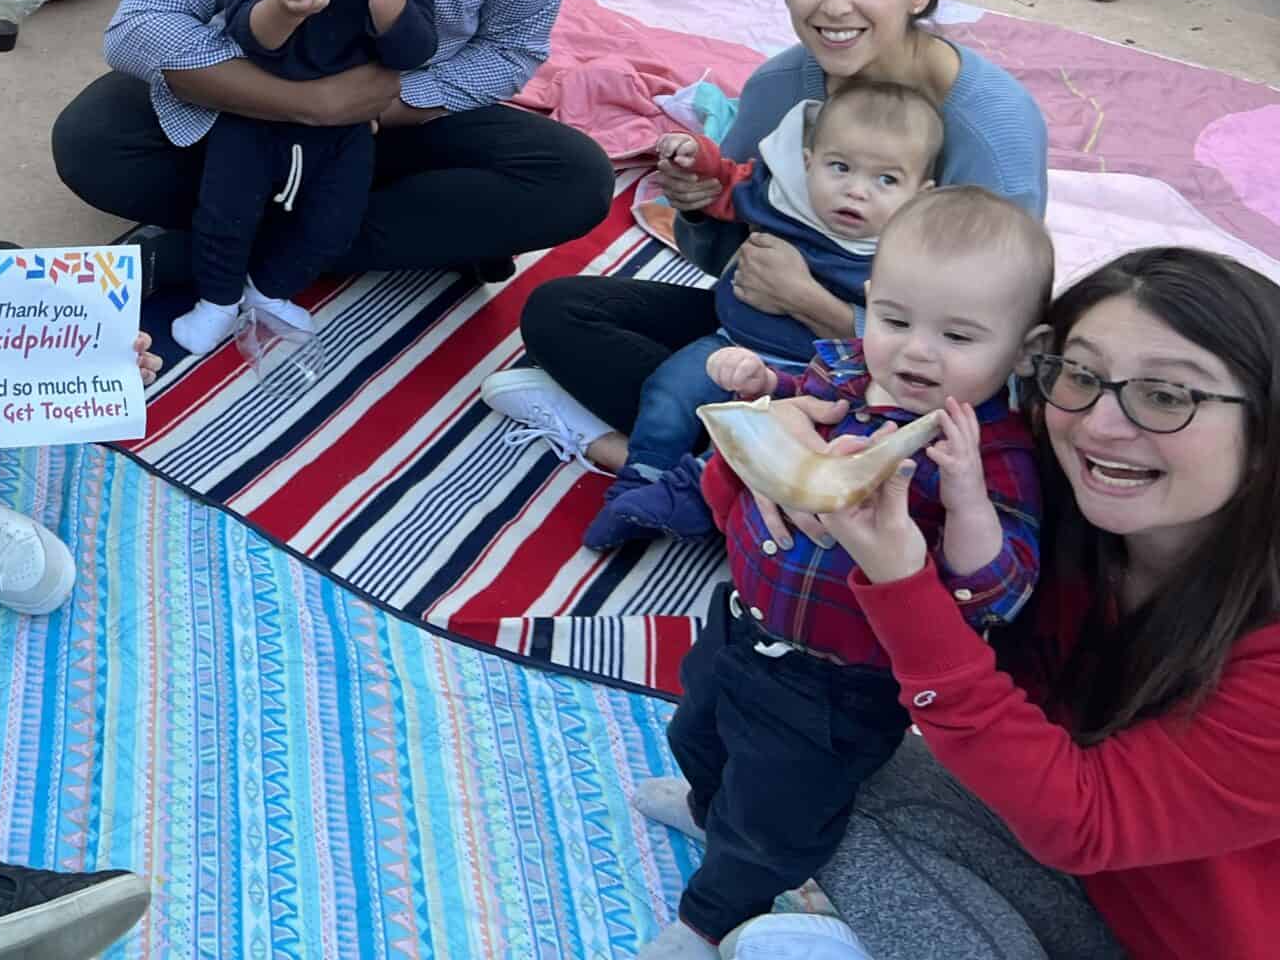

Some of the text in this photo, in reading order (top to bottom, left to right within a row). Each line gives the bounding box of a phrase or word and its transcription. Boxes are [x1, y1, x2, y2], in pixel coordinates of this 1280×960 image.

[51, 304, 88, 322] you,
[12, 382, 32, 396] so
[38, 376, 87, 395] much
[91, 375, 123, 393] fun
[3, 402, 35, 424] Get
[40, 397, 129, 424] Together!
